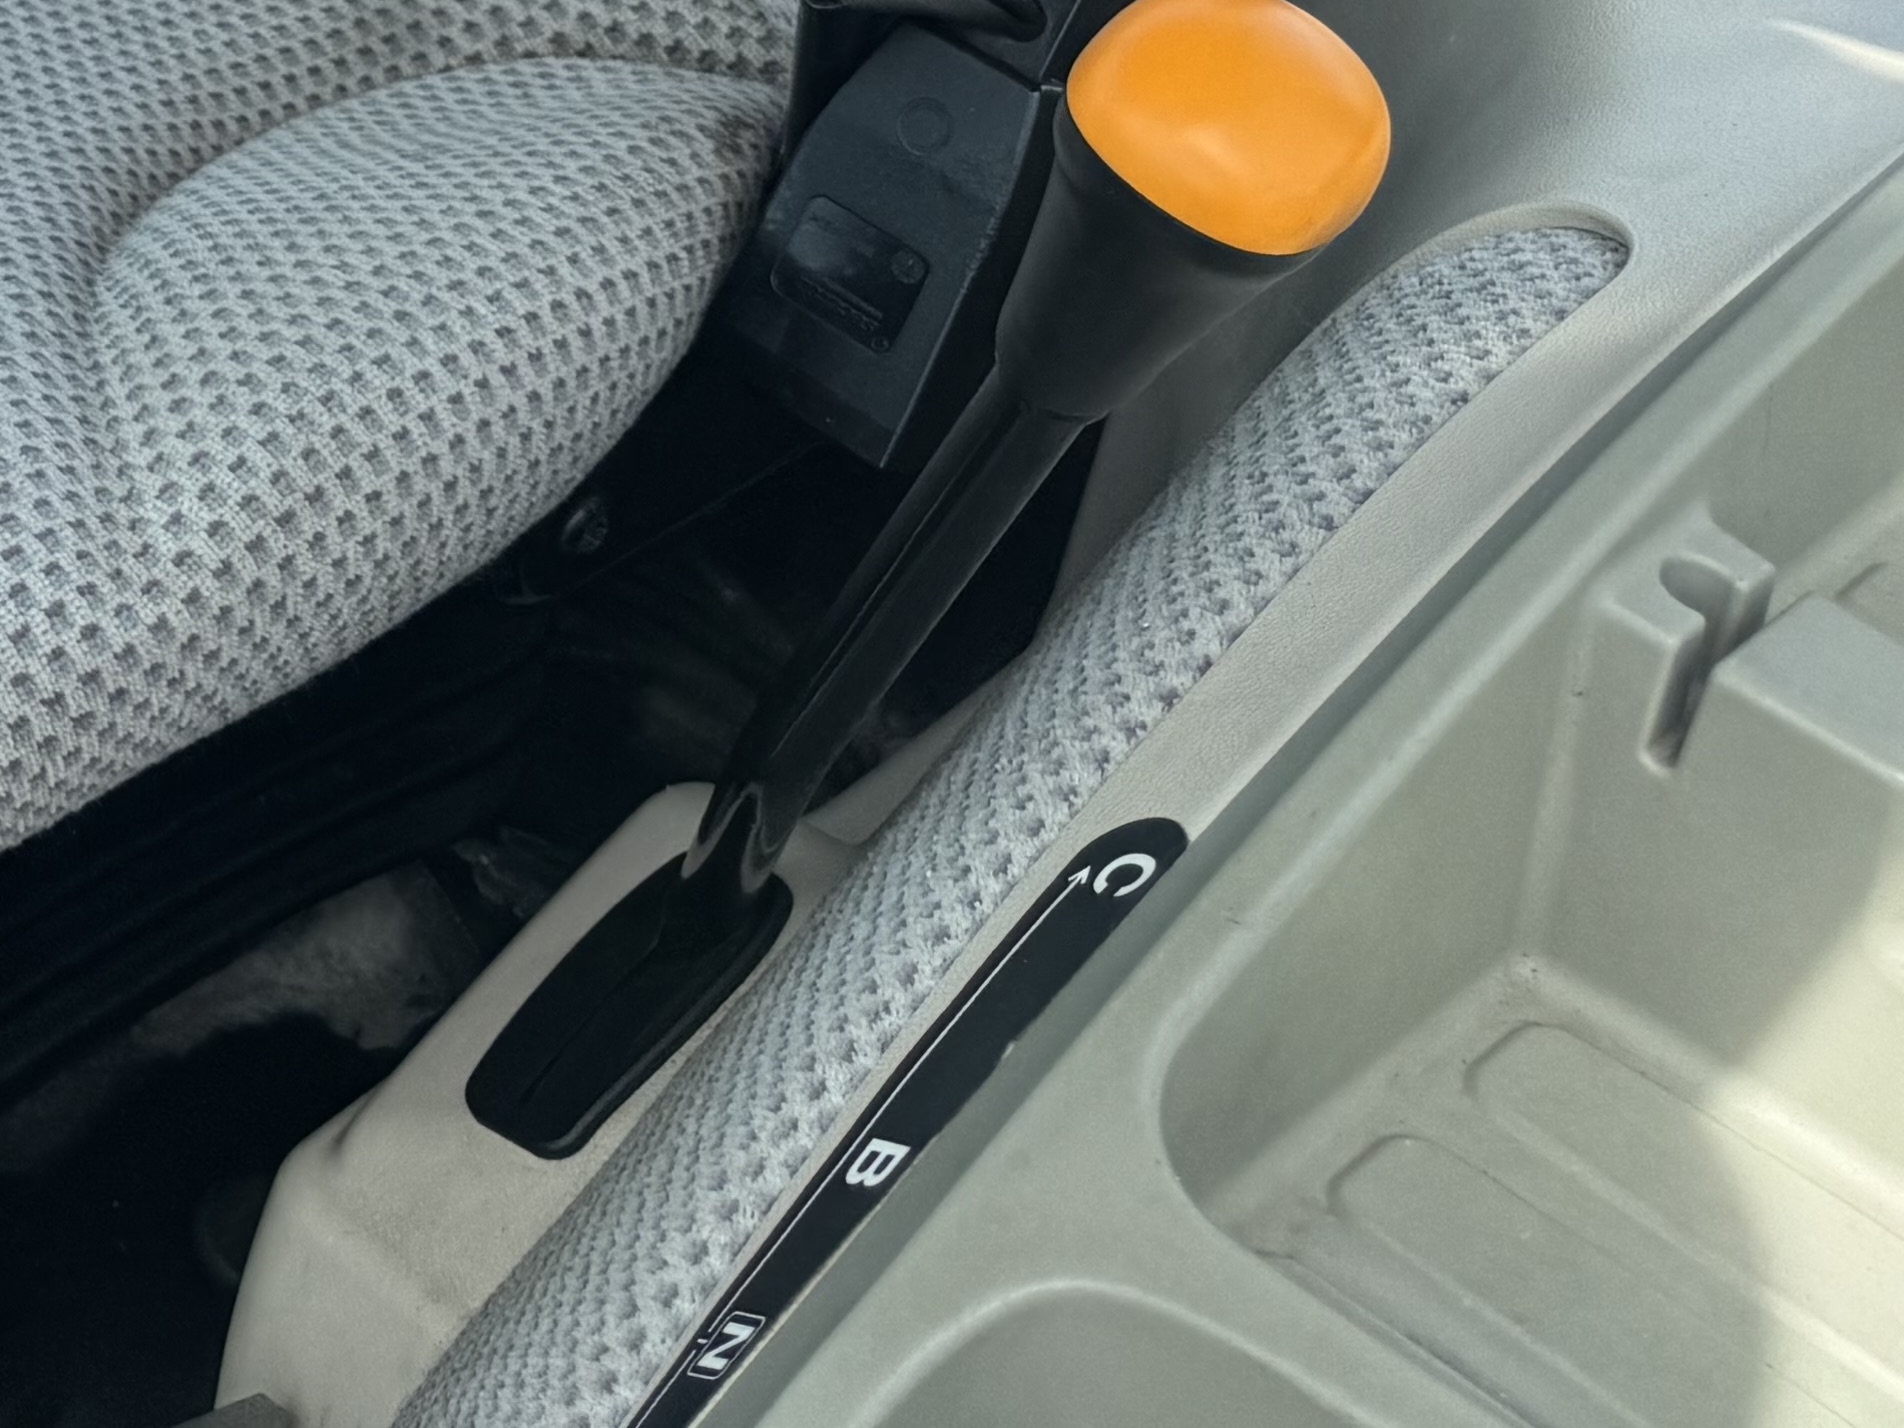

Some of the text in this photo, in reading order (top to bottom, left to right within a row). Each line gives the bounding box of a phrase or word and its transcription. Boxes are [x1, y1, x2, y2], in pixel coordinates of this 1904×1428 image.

[1093, 852, 1156, 897] C
[845, 1137, 911, 1187] B
[696, 1321, 756, 1371] N
